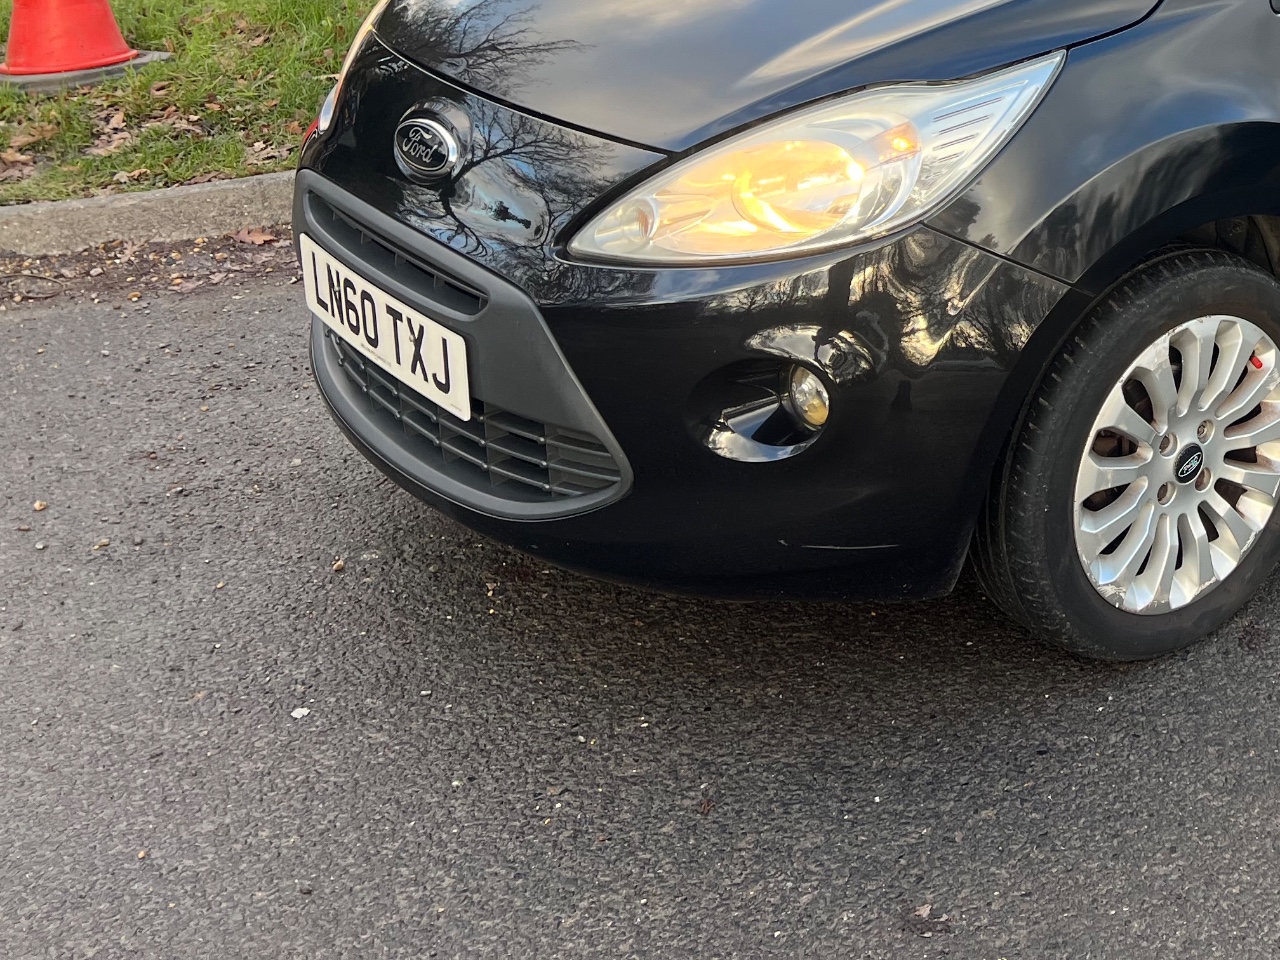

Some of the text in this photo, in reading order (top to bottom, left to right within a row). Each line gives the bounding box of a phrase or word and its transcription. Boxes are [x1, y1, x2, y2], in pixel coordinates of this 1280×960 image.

[402, 126, 439, 164] Ford
[311, 251, 451, 395] LN60 TXJ
